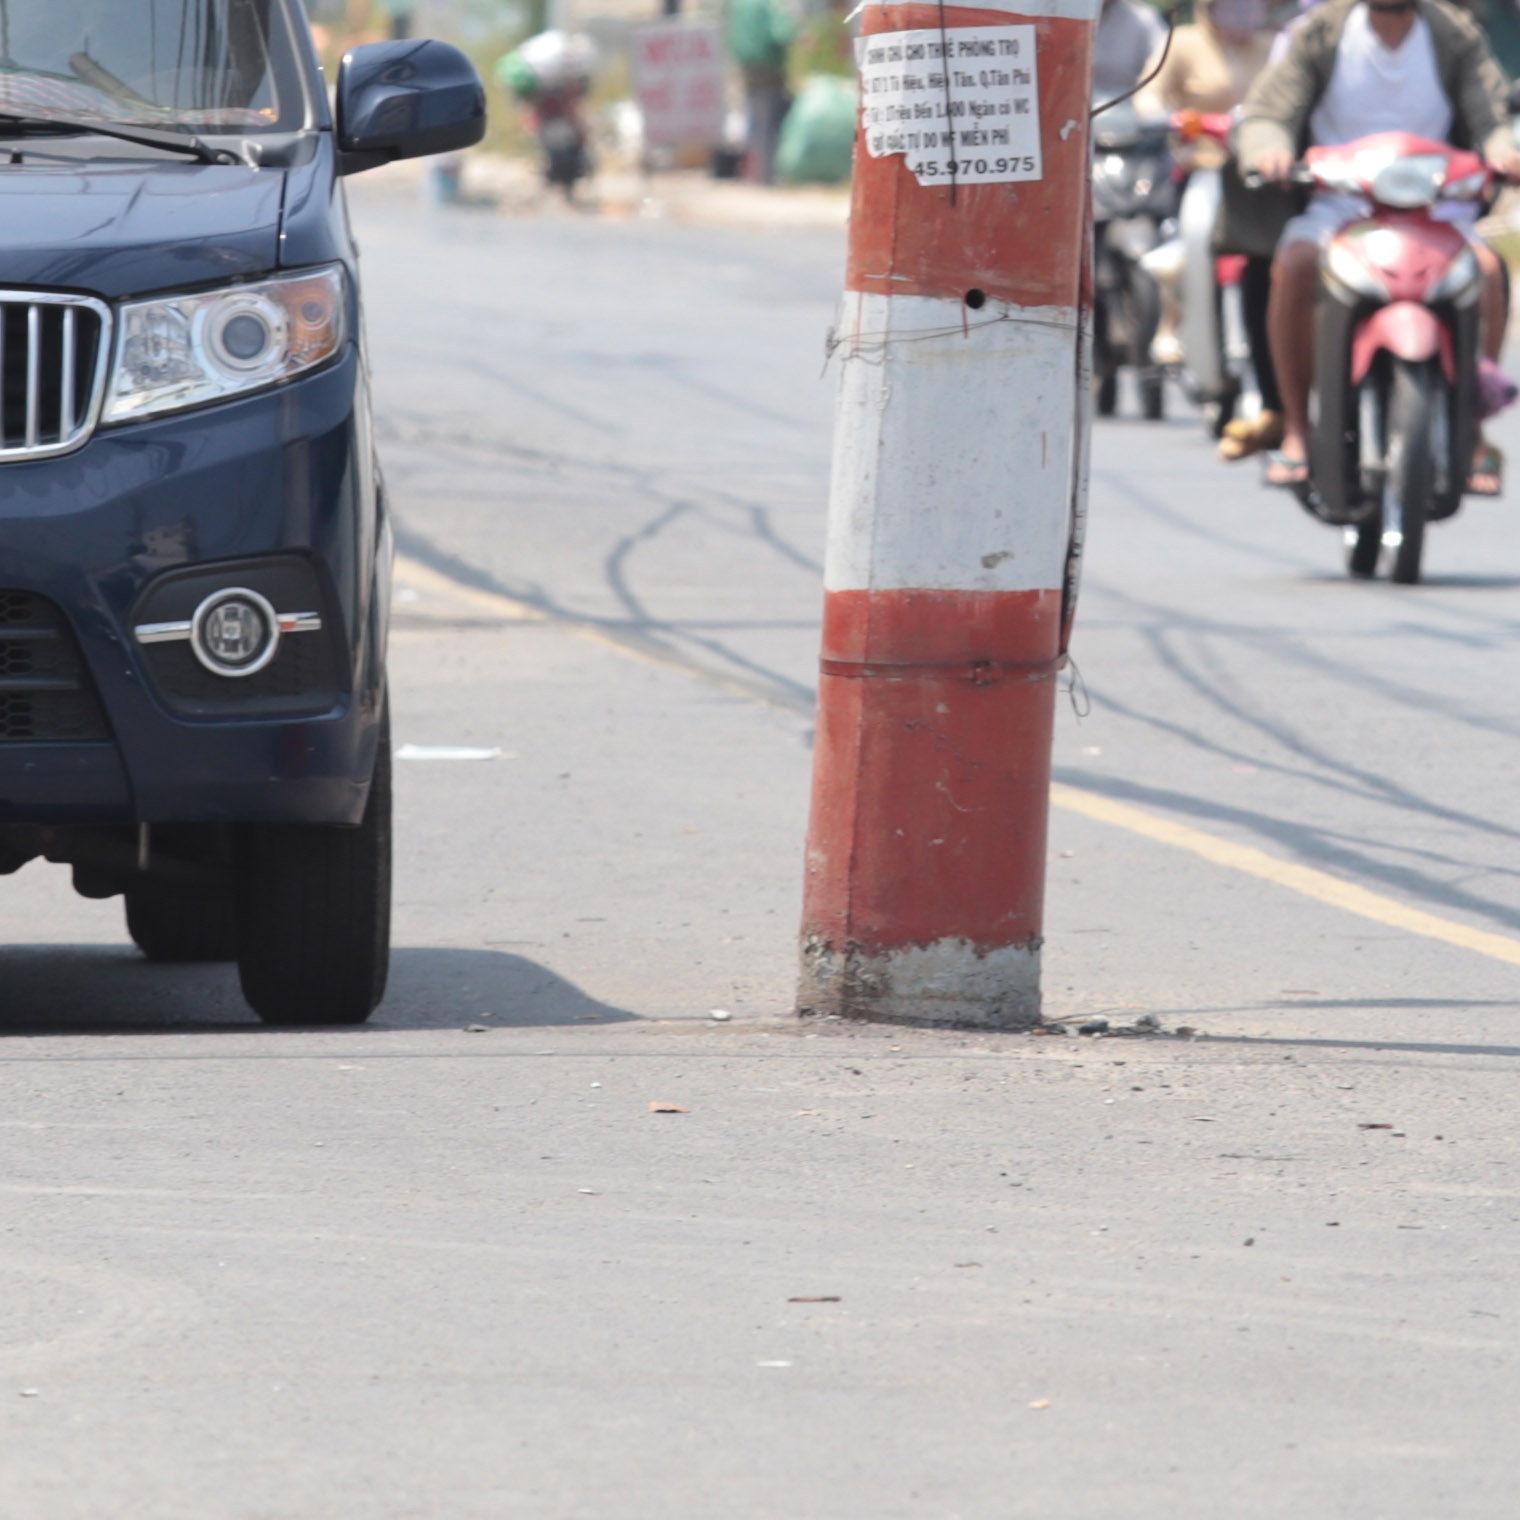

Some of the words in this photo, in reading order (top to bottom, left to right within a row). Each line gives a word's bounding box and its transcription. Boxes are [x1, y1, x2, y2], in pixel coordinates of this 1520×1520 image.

[906, 43, 925, 60] CHO
[958, 35, 996, 57] PHÒNG
[998, 38, 1020, 60] TRỌ
[913, 155, 1035, 177] 45.970.975
